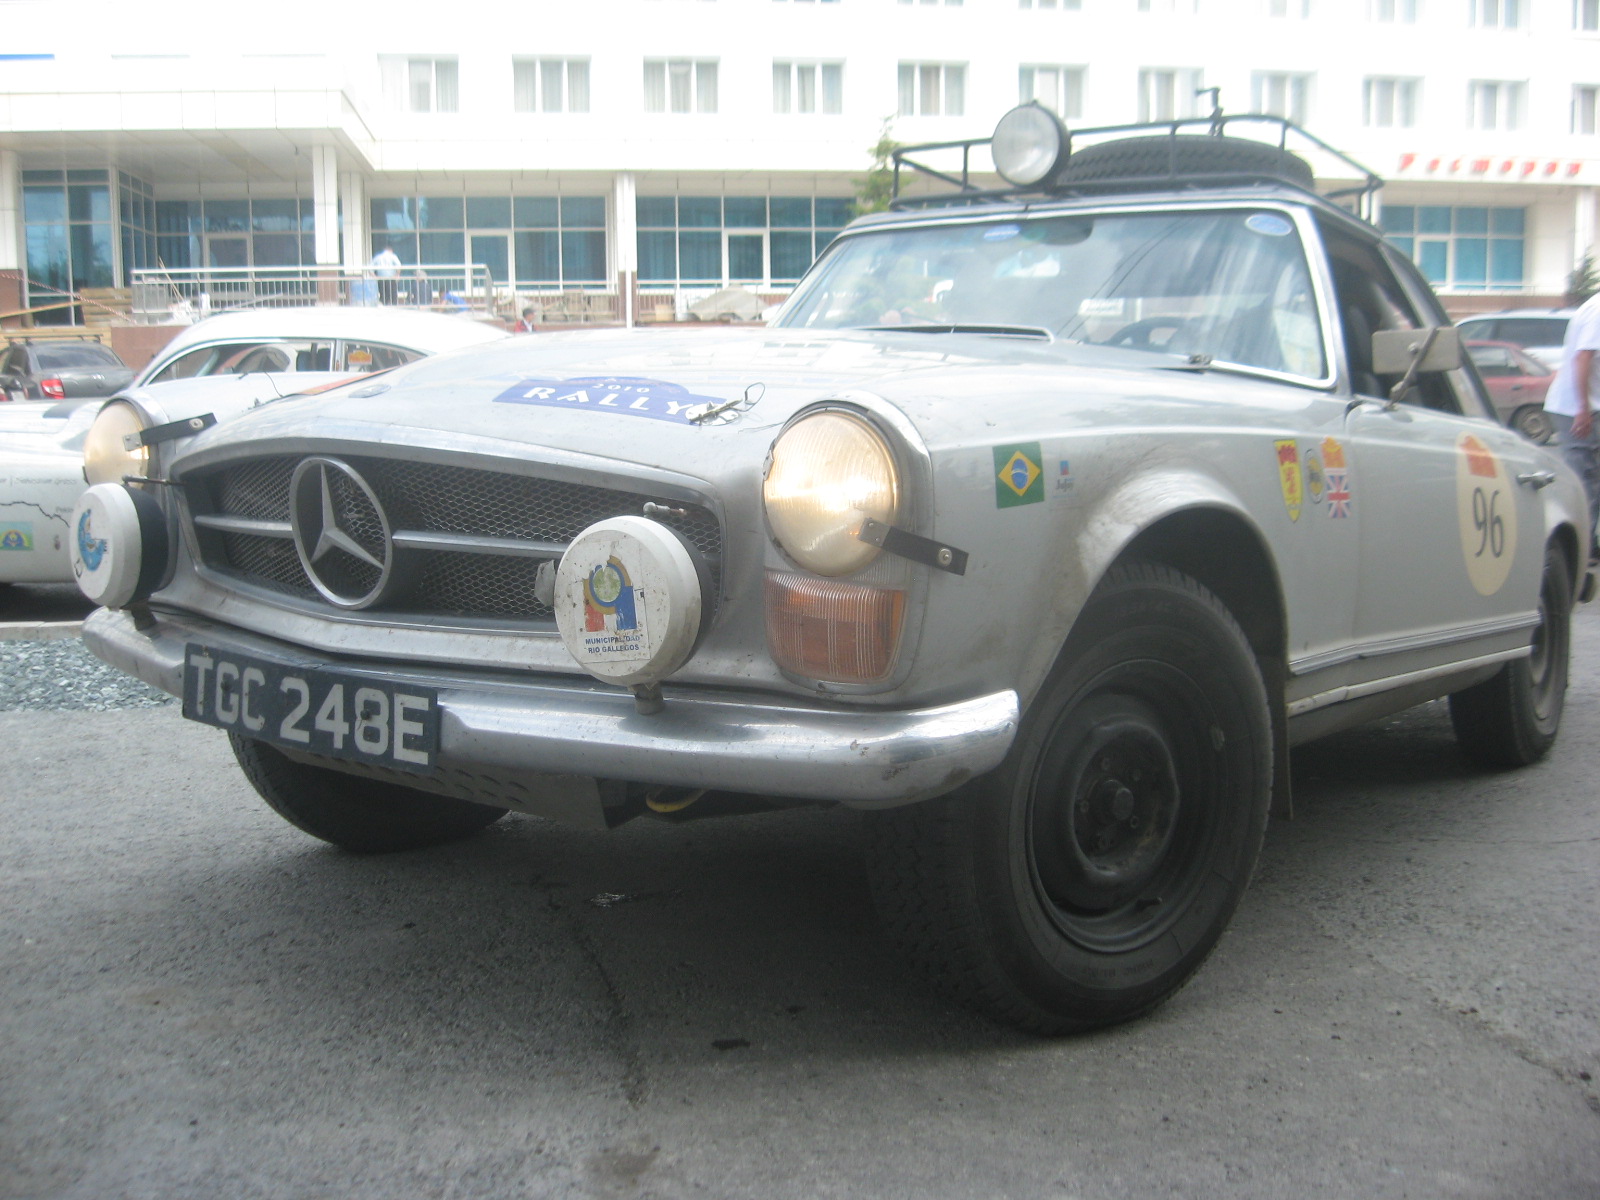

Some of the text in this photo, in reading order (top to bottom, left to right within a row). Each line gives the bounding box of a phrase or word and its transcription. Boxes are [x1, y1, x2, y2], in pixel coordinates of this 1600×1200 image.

[523, 386, 694, 415] RALLY
[592, 383, 650, 393] 2010
[1473, 487, 1504, 558] 96
[588, 644, 640, 654] RIO GALLEGOS
[190, 654, 429, 765] TGC 248E
